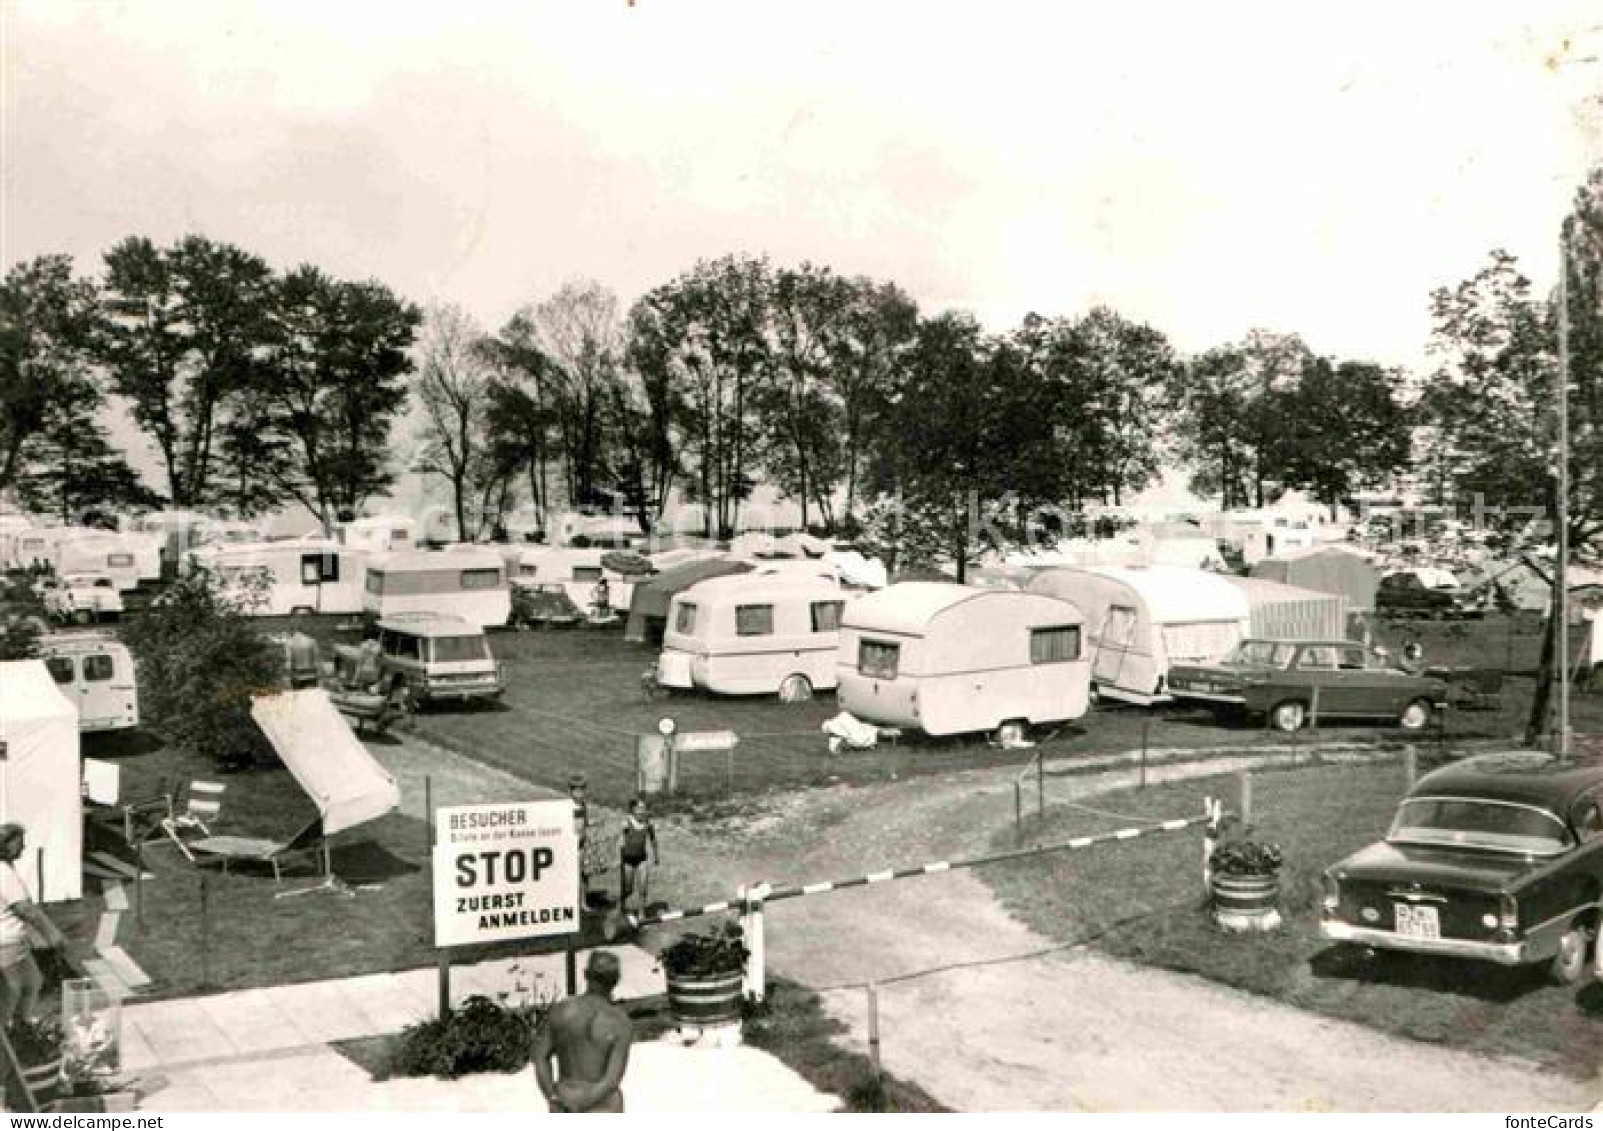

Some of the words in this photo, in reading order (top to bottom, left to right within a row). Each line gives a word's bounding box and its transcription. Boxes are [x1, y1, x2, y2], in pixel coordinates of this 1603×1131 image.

[449, 809, 527, 830] BESUCHER
[455, 846, 554, 888] STOP
[456, 892, 525, 913] ZUERST
[478, 906, 574, 930] ANMELDEN
